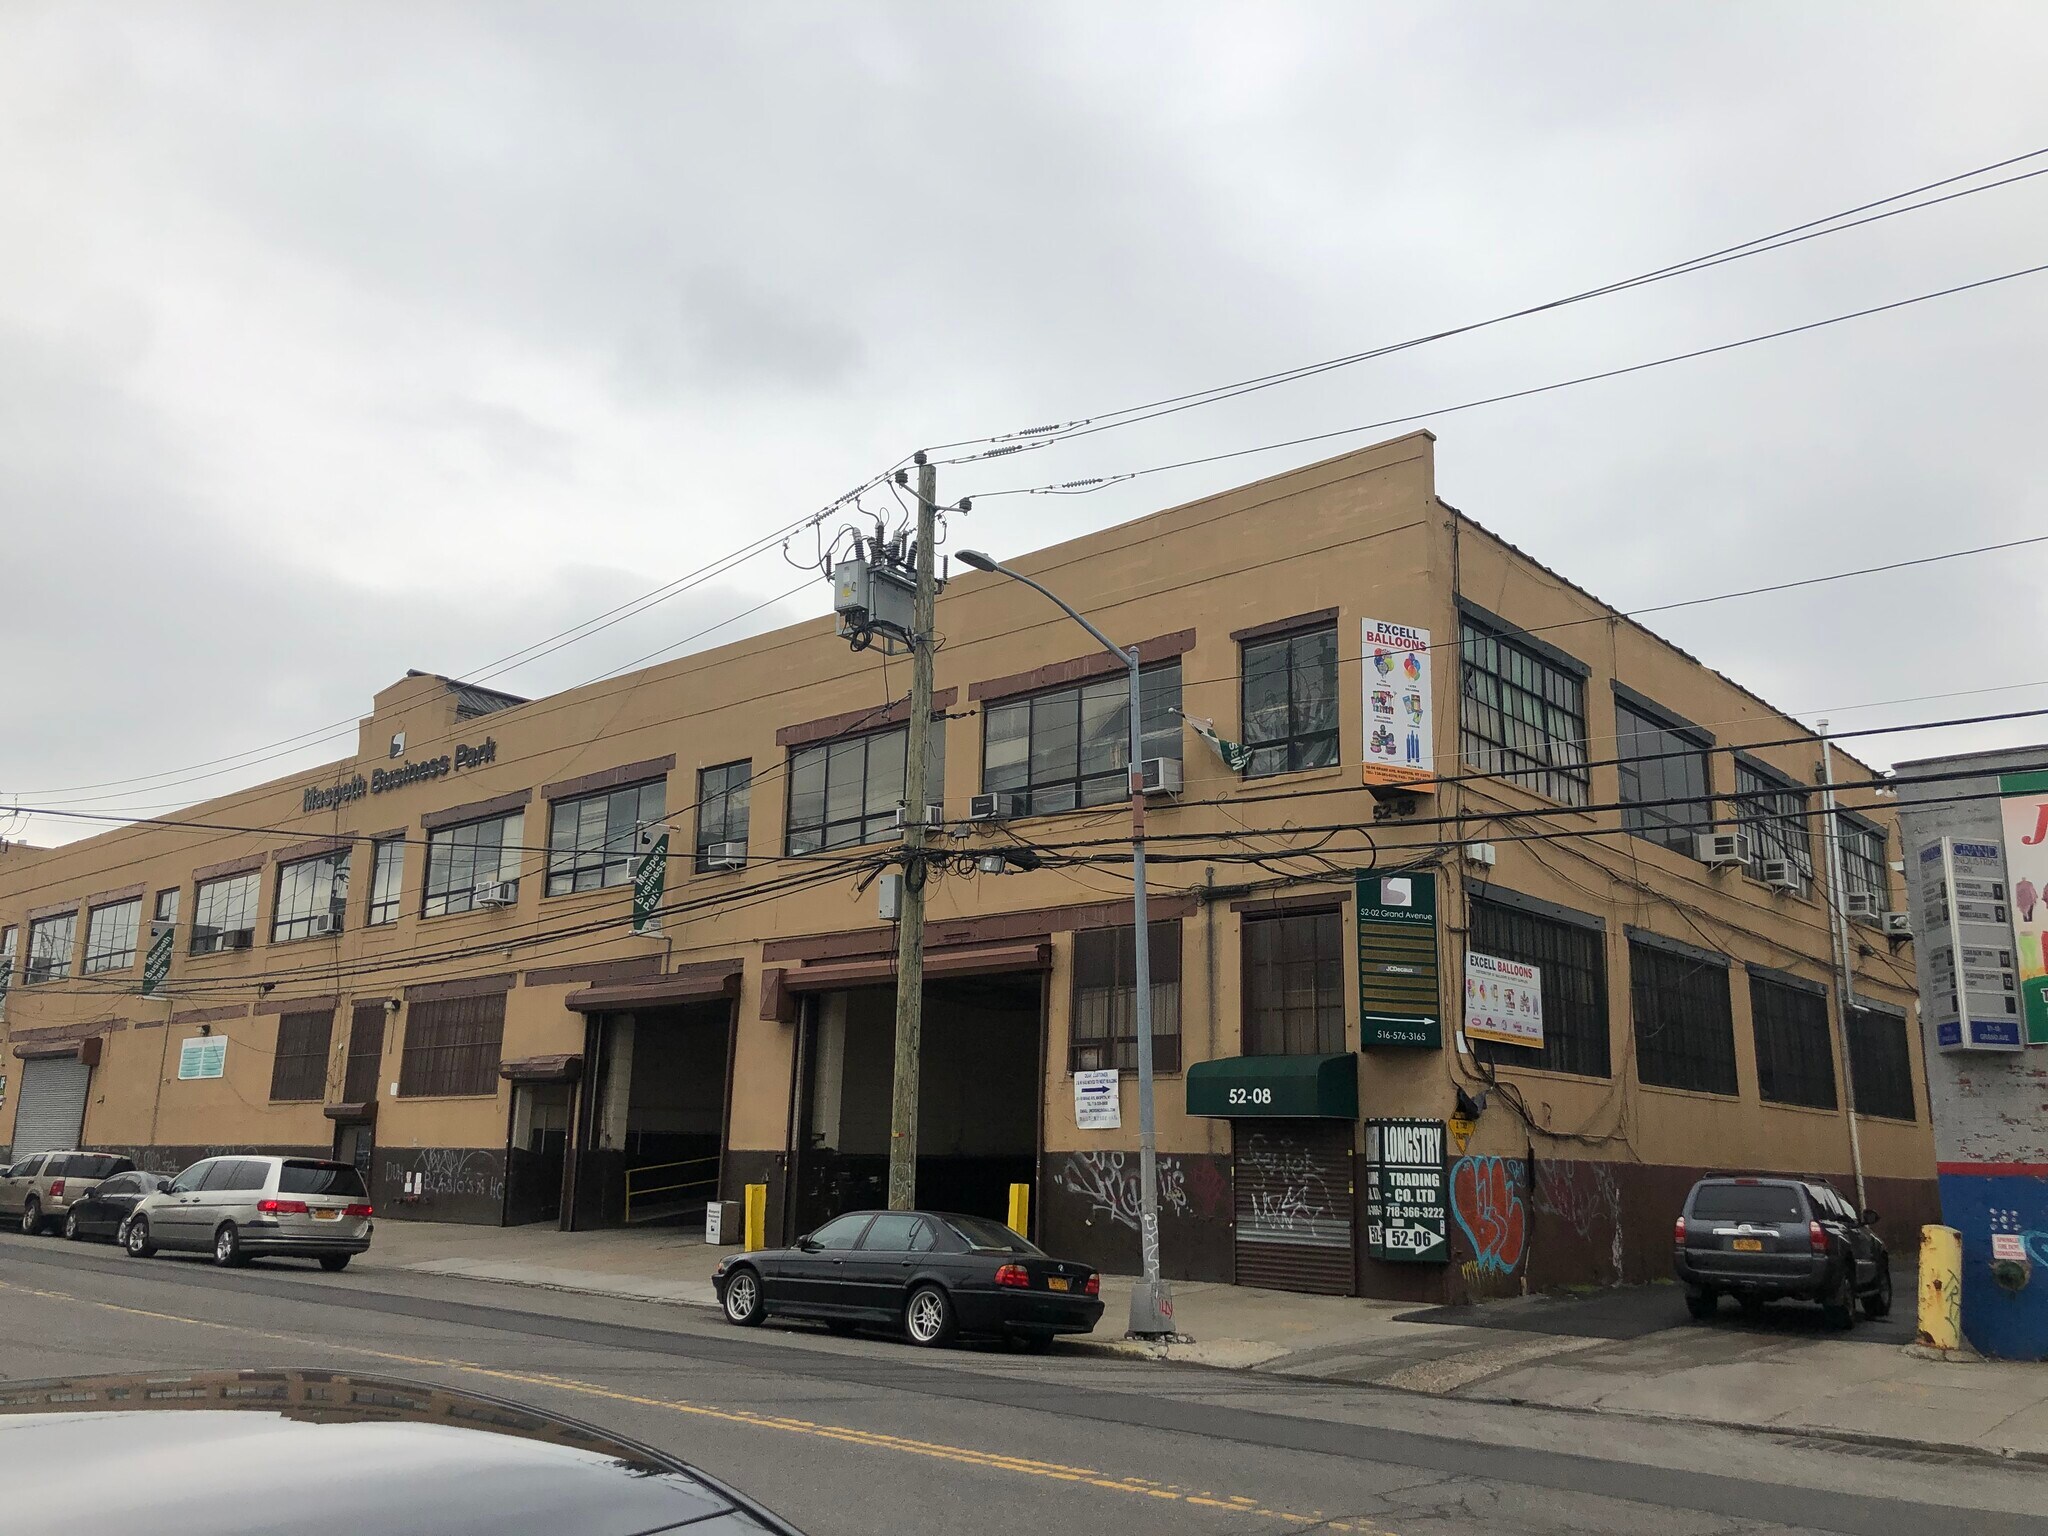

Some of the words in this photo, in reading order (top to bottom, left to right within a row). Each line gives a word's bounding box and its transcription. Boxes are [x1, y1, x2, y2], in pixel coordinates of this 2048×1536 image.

[1377, 622, 1419, 640] EXCELL
[1366, 631, 1427, 651] BALLOONS
[303, 773, 367, 813] Maspeth
[370, 753, 451, 794] Business
[454, 736, 497, 772] Park
[1953, 844, 1998, 859] GRAND
[635, 845, 666, 886] Maspeth
[1954, 856, 1999, 867] INDUSTRIAL
[1360, 908, 1380, 917] 52-02
[1381, 909, 1404, 918] Grand
[1405, 911, 1433, 920] Avenue
[1386, 965, 1413, 973] JCDecaux
[1470, 954, 1496, 971] EXCELL
[1497, 961, 1533, 979] BALLOONS
[1376, 1030, 1426, 1041] 516-576-3165
[1229, 1088, 1272, 1105] 52-08
[1384, 1126, 1441, 1164] LONGSTRY
[1389, 1172, 1440, 1187] TRADING
[1394, 1188, 1414, 1202] CO.
[1416, 1189, 1436, 1203] LTD
[1385, 1206, 1444, 1219] 718-366-3222
[1391, 1230, 1431, 1247] 52-06
